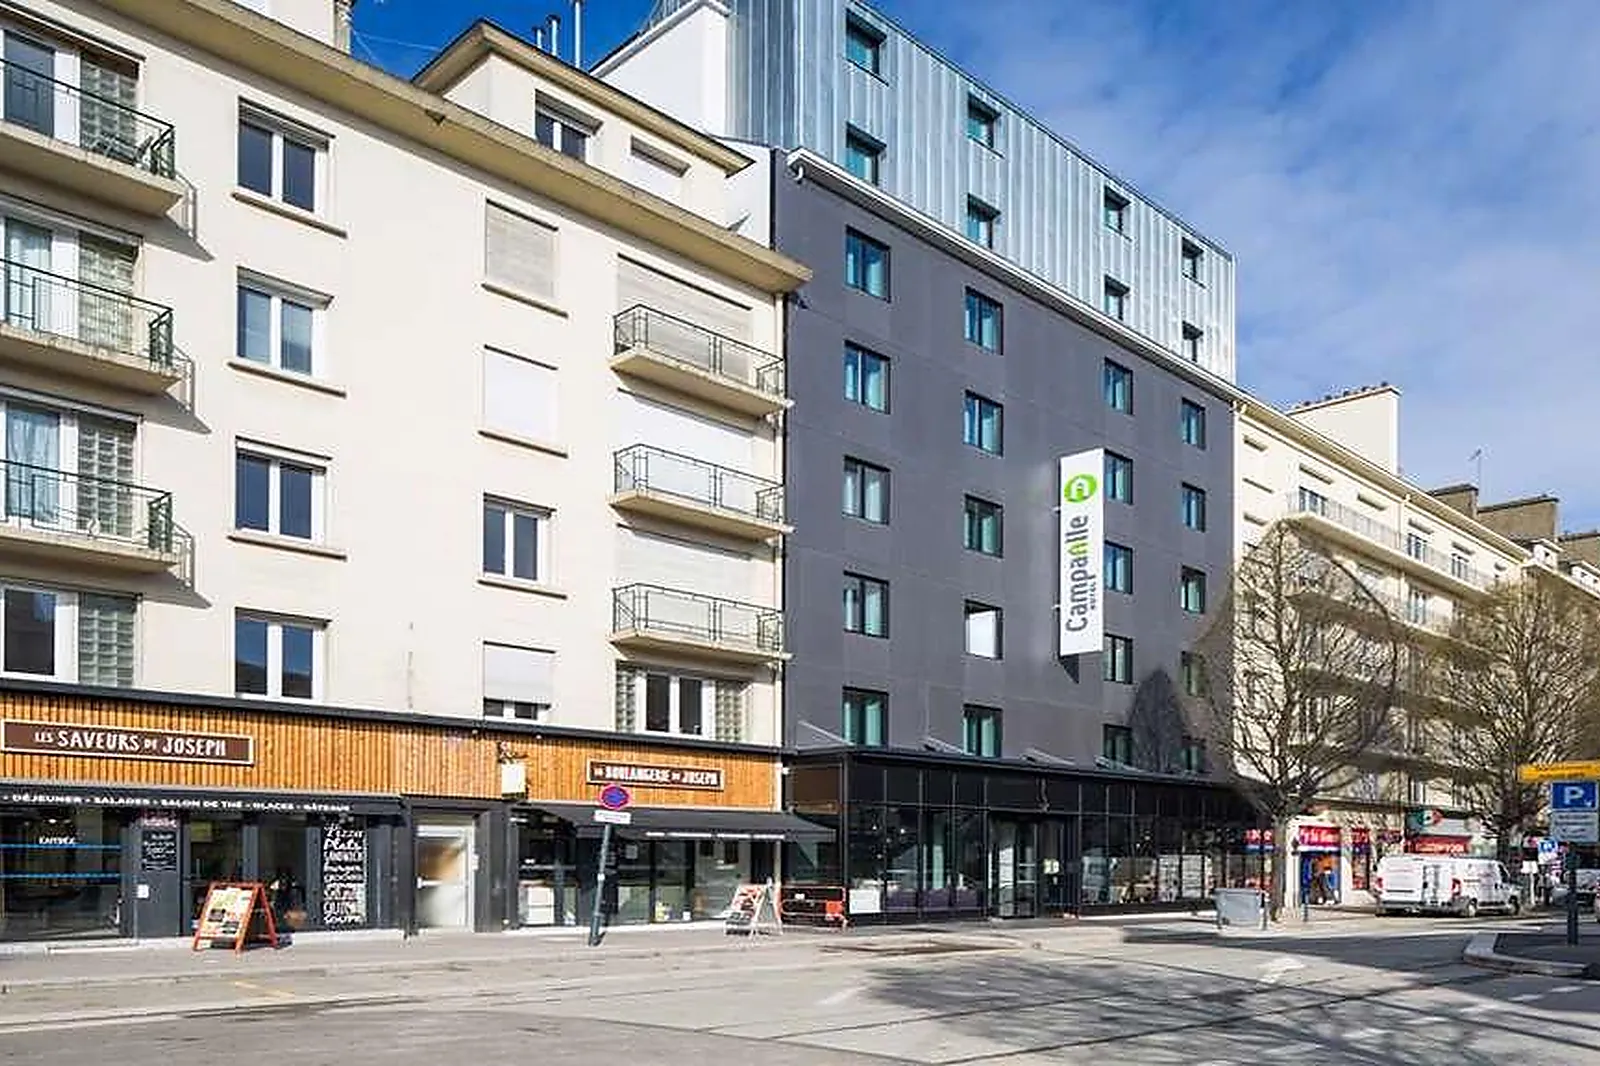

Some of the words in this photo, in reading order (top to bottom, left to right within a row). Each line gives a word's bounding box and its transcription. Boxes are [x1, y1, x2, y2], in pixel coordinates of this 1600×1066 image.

[34, 731, 55, 744] LES
[57, 731, 139, 752] SAVEURS
[144, 739, 157, 751] DE
[162, 737, 226, 757] JOSEPH
[682, 772, 719, 786] JOSEPH
[1564, 786, 1584, 805] P
